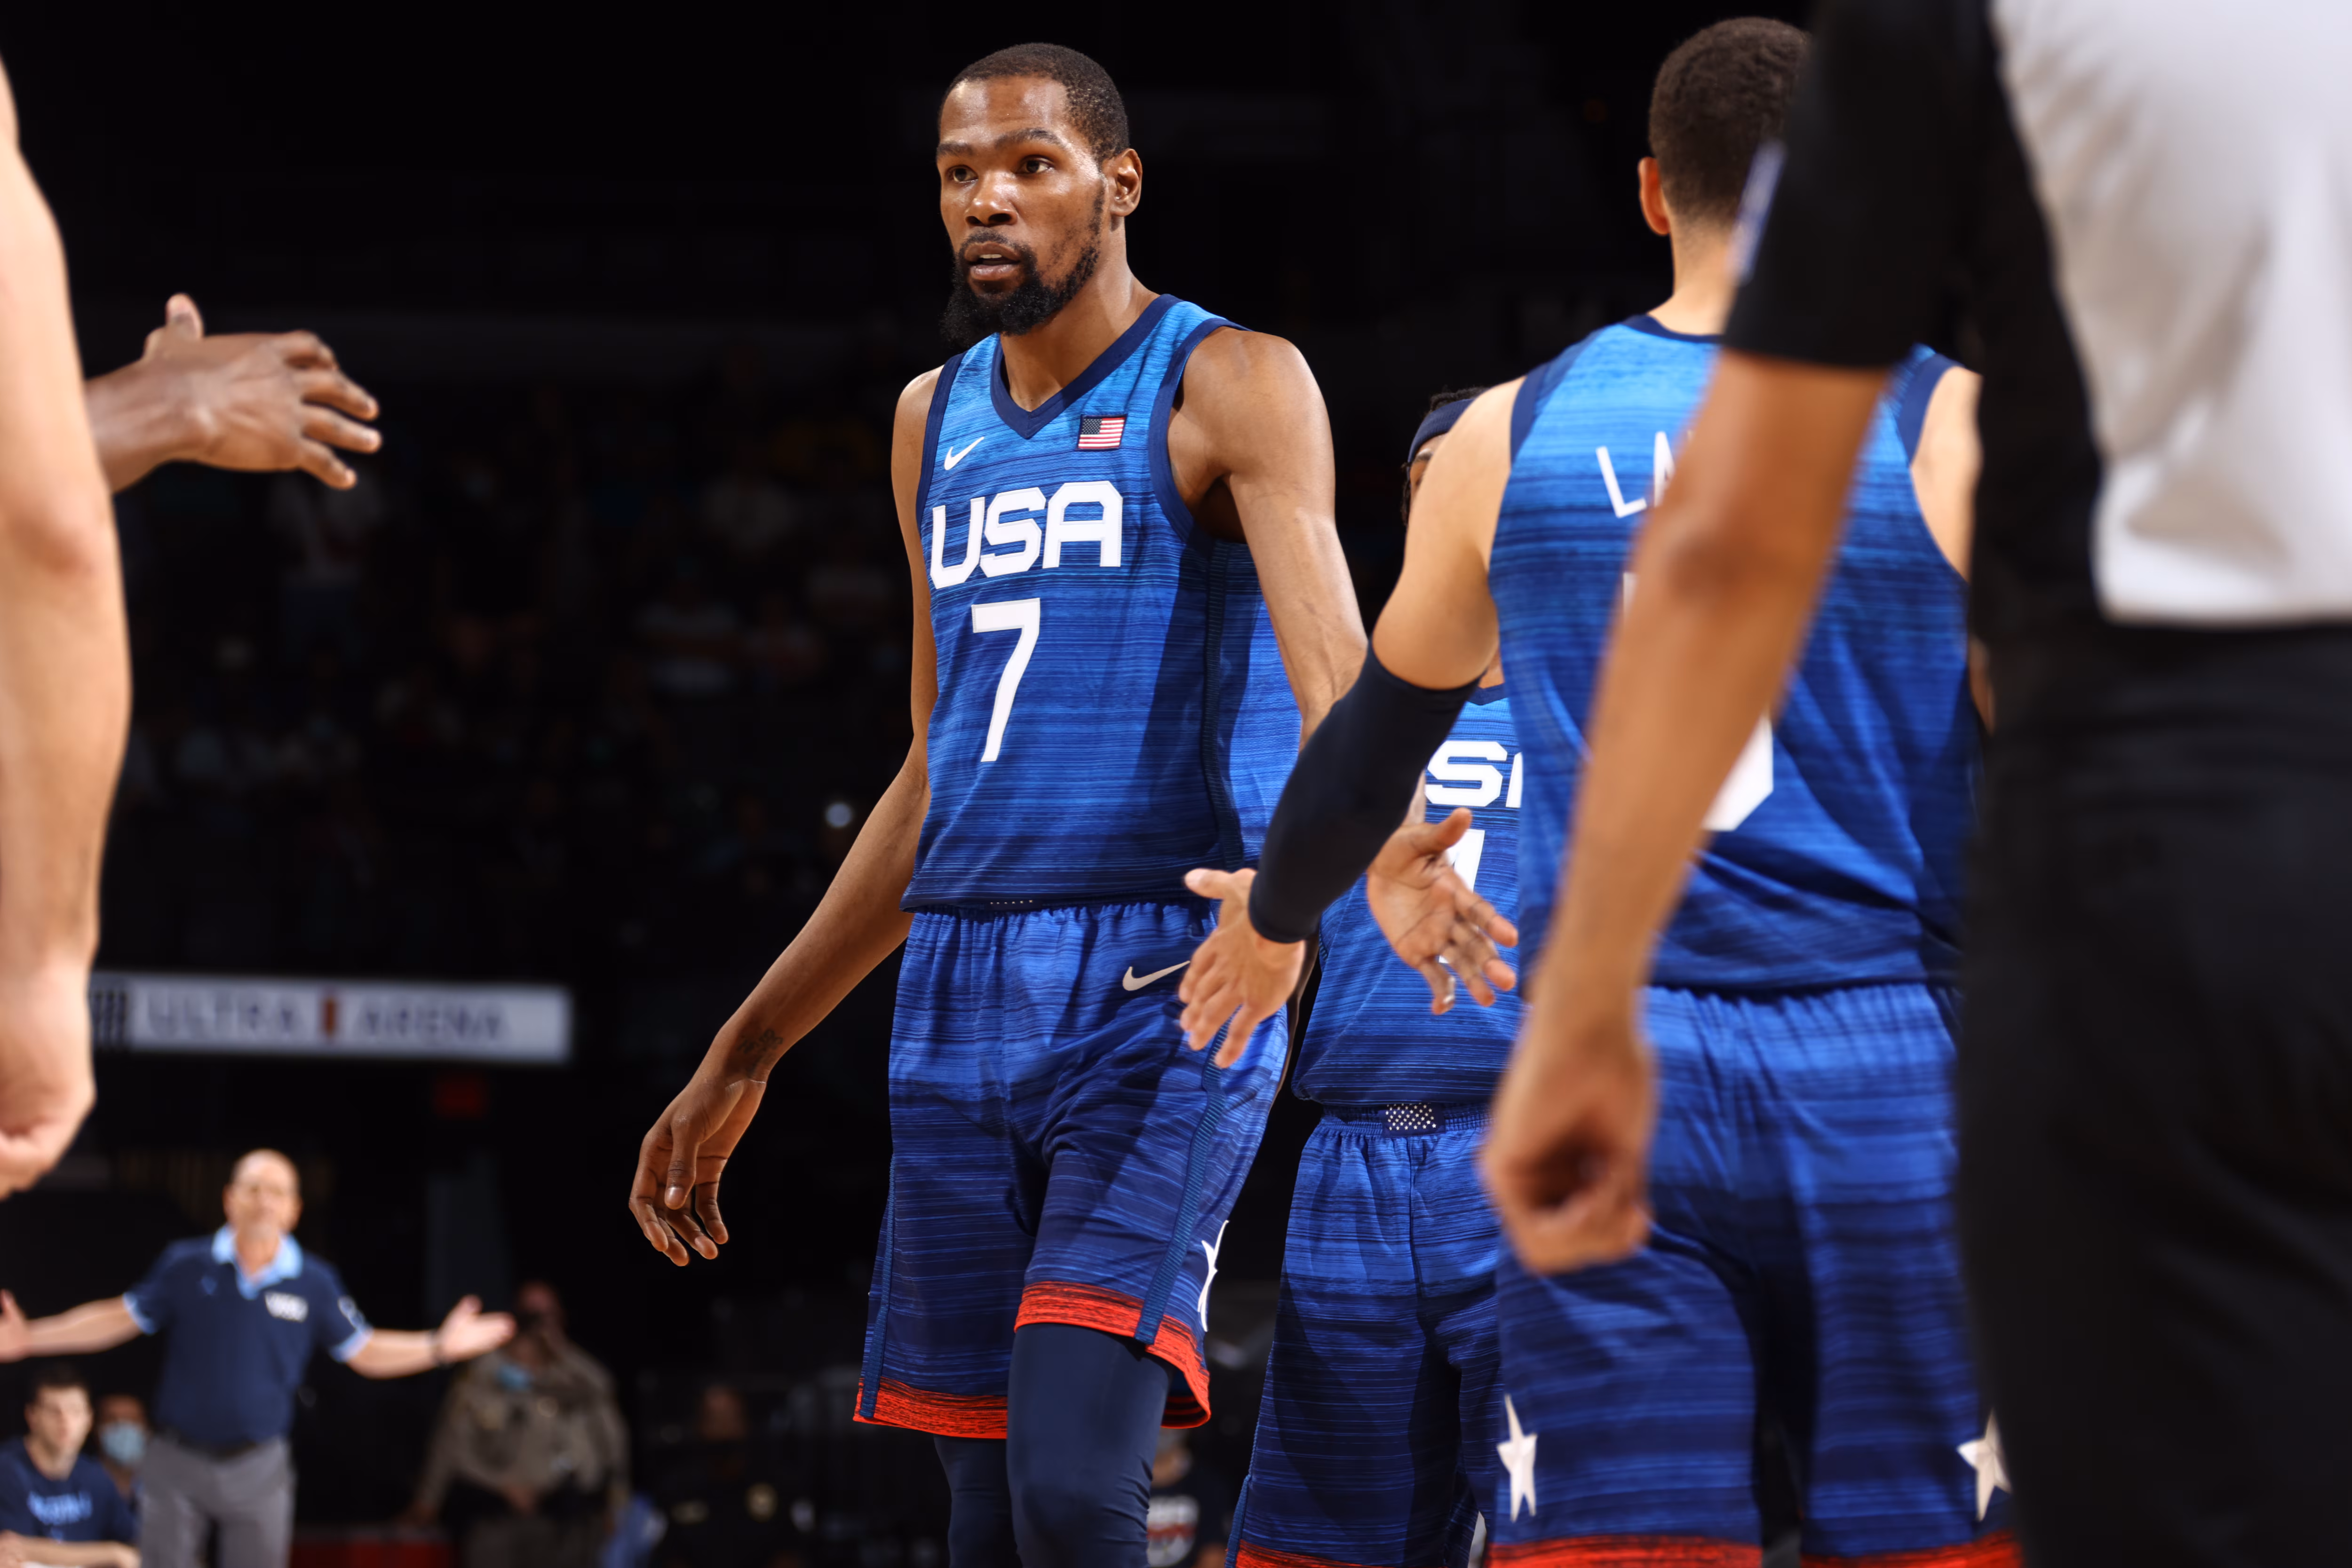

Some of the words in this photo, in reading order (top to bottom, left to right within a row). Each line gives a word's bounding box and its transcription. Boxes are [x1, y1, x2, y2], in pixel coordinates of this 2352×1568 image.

[930, 480, 1123, 590] USA
[971, 597, 1041, 762] 7
[147, 990, 305, 1040] ULTRA
[354, 995, 509, 1046] ARENA
